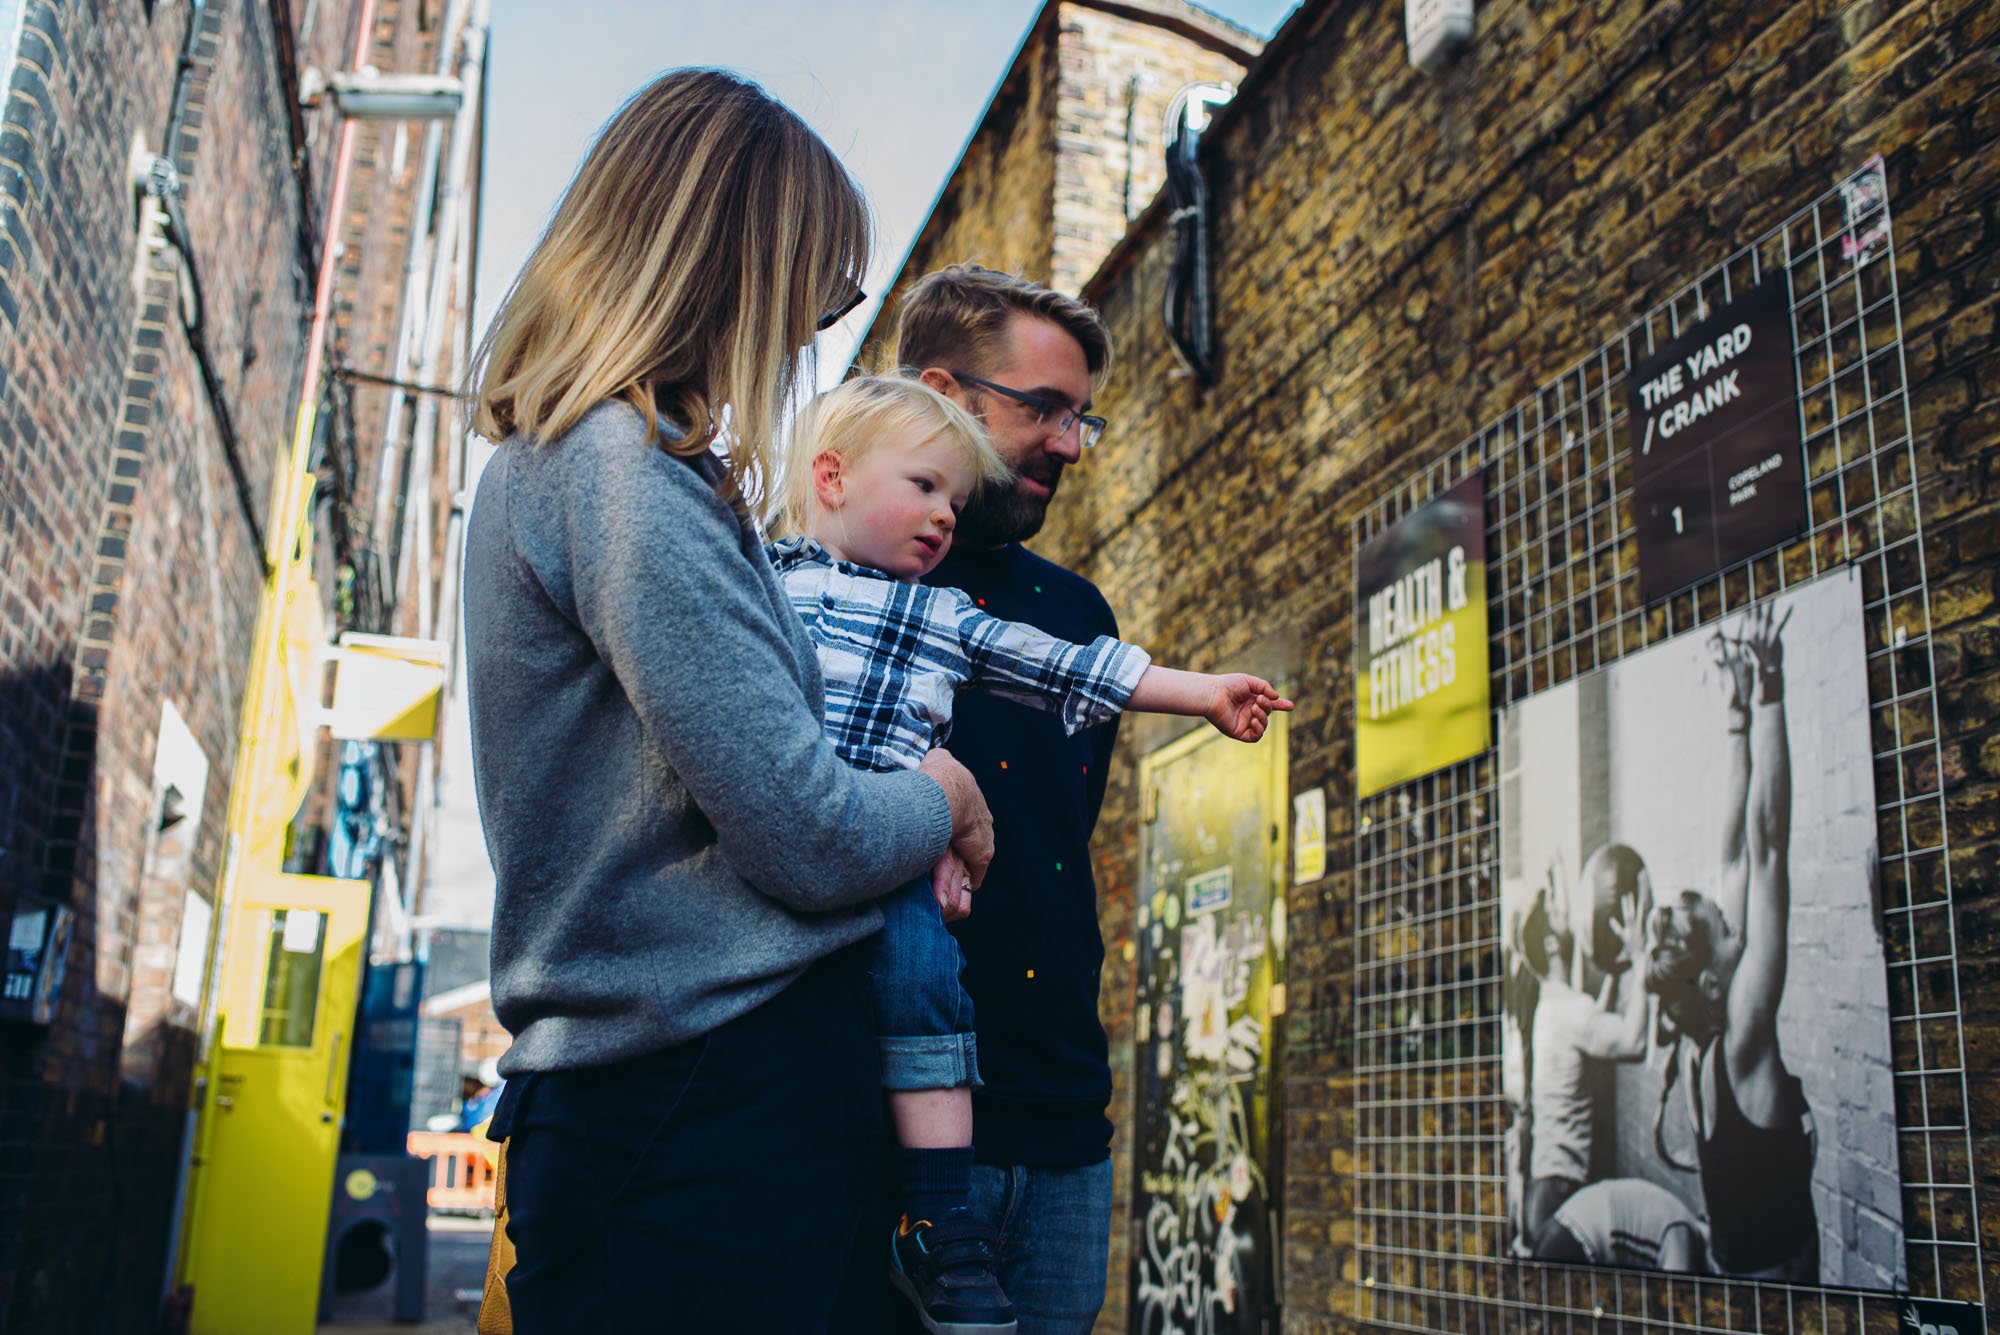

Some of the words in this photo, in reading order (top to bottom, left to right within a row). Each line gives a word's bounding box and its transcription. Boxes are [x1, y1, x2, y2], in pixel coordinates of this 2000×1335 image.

[1639, 363, 1684, 411] THE
[1686, 323, 1752, 381] YARD
[1728, 454, 1783, 490] COPELAND
[1729, 483, 1757, 507] PARK
[1672, 505, 1683, 535] 1
[1369, 558, 1442, 654] HEALTH
[1448, 545, 1468, 612] &
[1370, 621, 1456, 720] FITNESS
